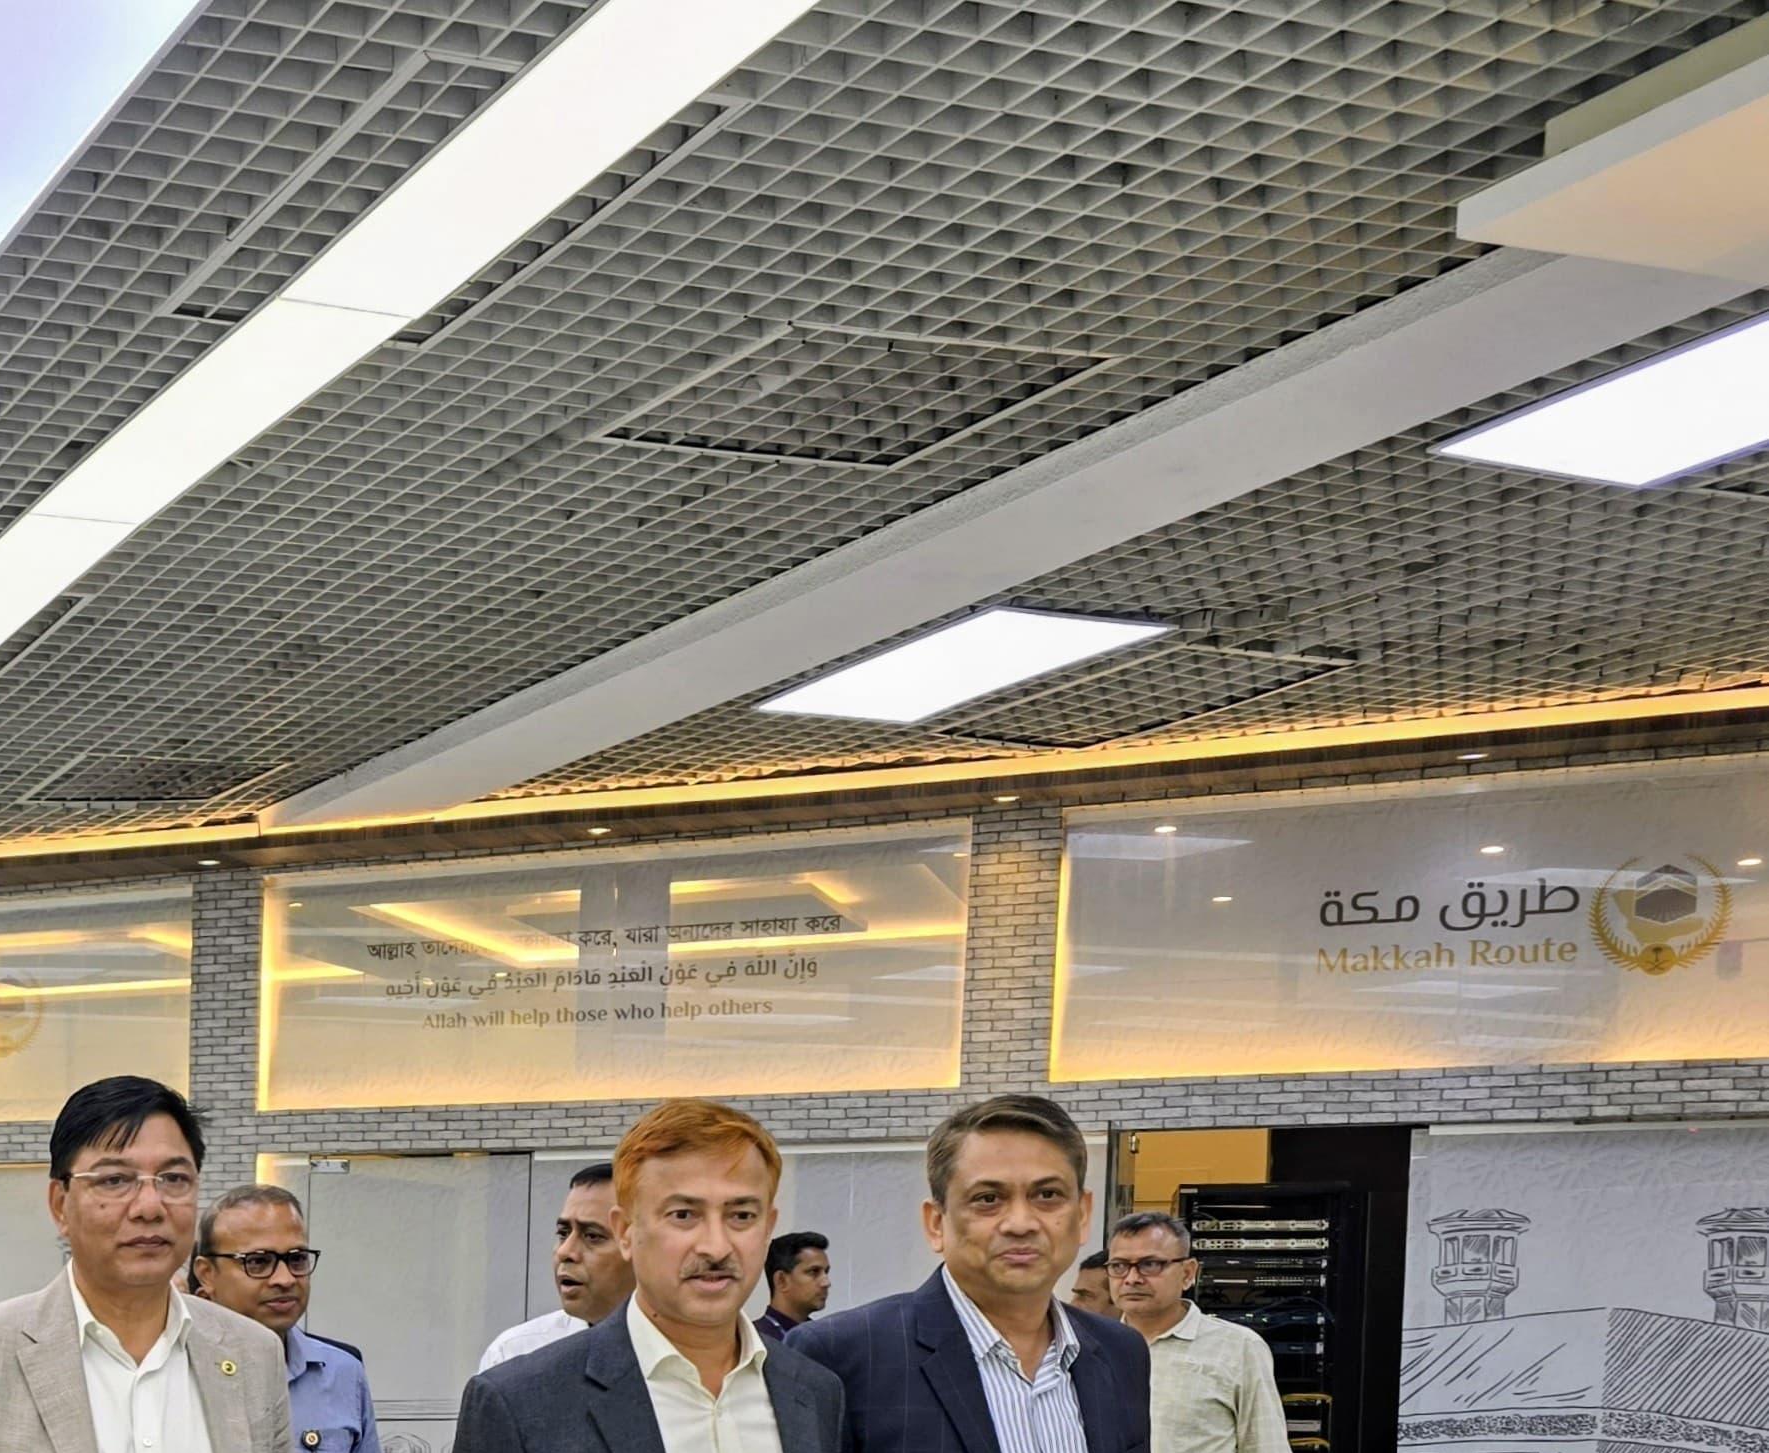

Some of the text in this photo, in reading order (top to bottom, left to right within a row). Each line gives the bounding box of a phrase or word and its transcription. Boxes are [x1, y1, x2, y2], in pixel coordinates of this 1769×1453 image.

[1318, 878, 1581, 932] طريق مكة
[367, 942, 417, 960] আল্লাহ
[804, 914, 844, 932] করে
[1316, 936, 1578, 976] Makkah Route
[422, 999, 773, 1029] Allah will help those who help others
